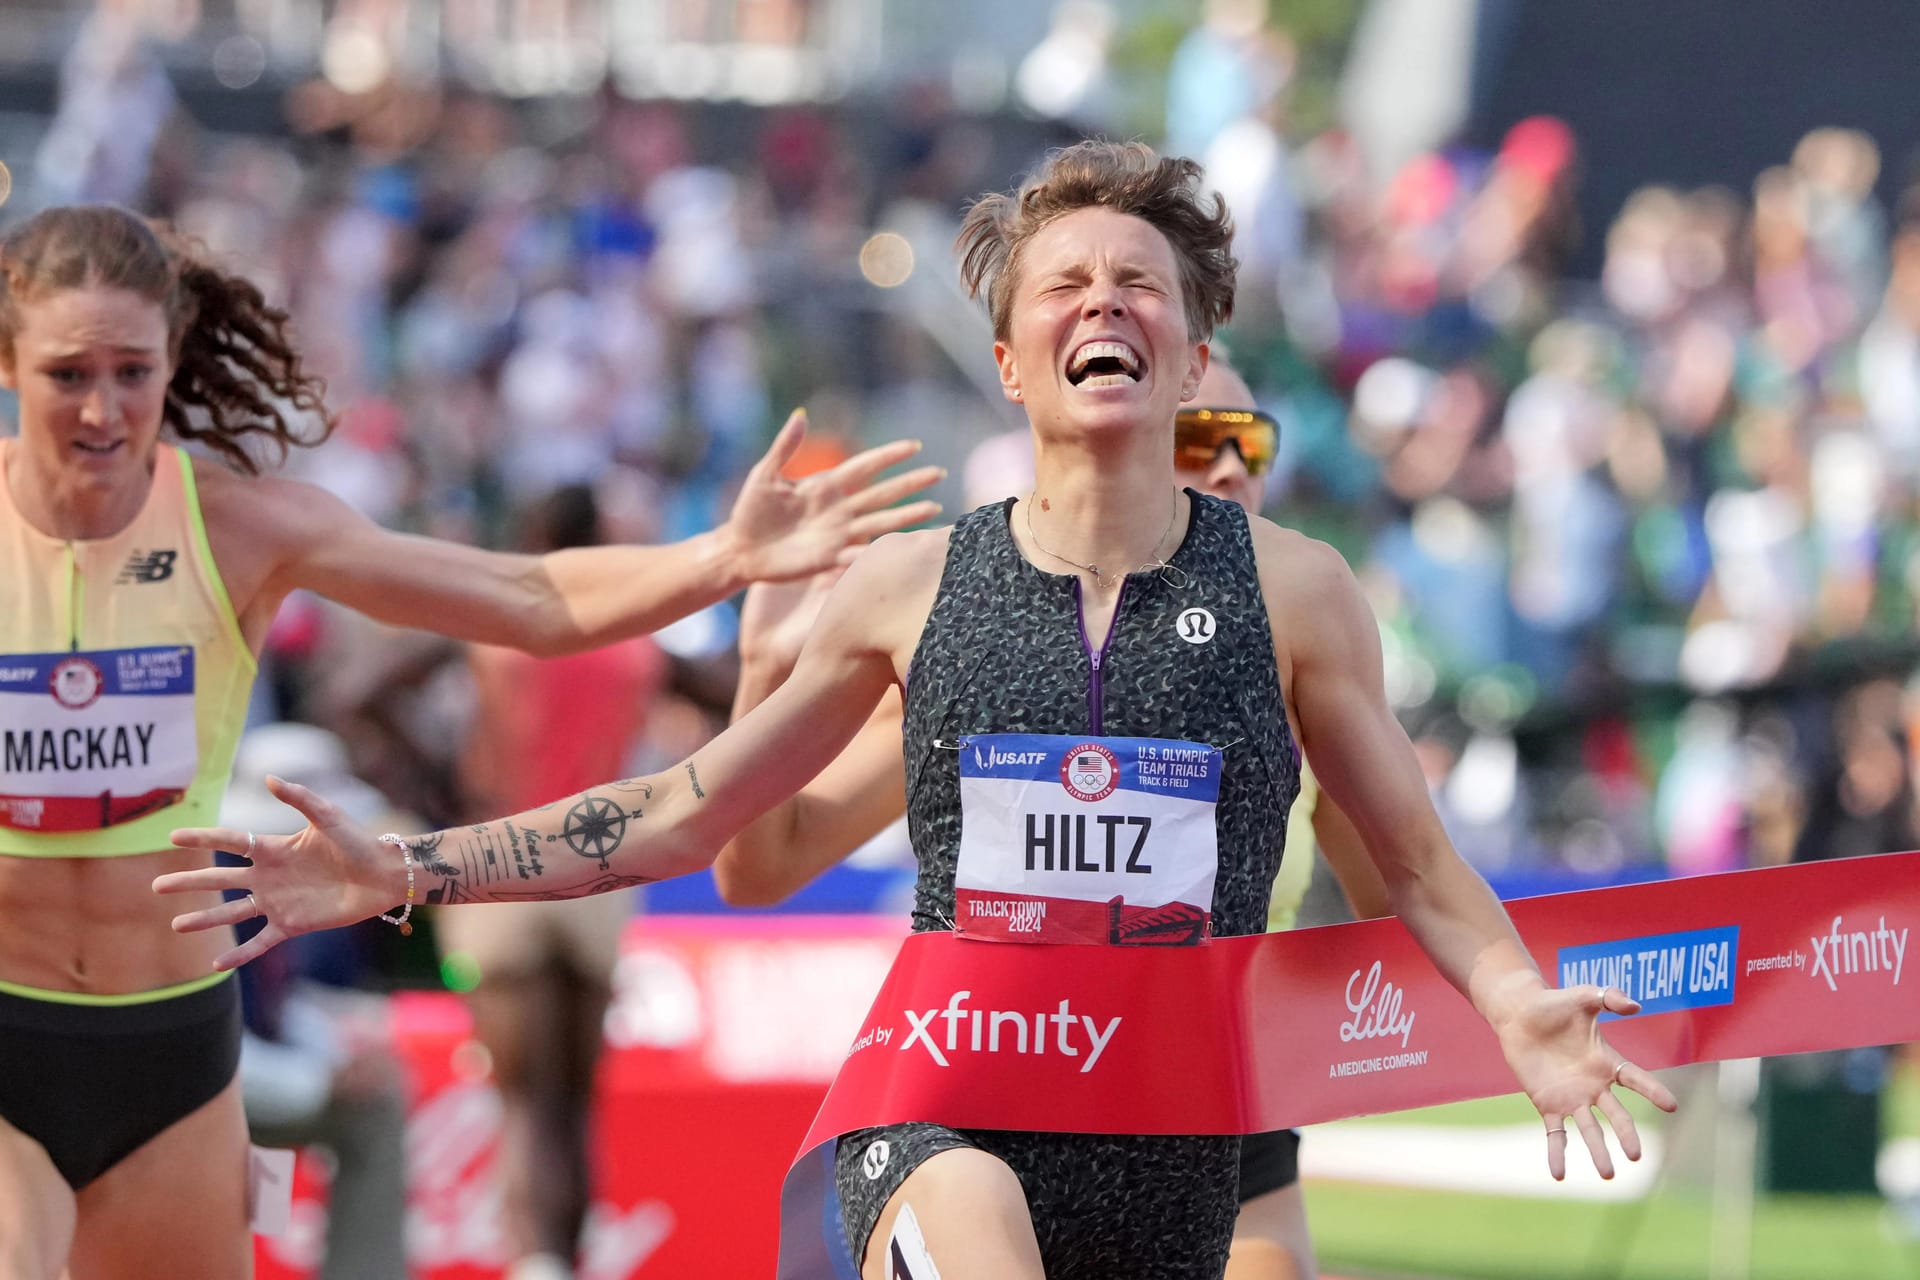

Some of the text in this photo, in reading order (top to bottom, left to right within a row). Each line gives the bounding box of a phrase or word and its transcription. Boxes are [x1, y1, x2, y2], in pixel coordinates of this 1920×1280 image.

[5, 722, 156, 773] MACKAY
[995, 752, 1047, 765] USATF
[1138, 746, 1209, 763] U.S. OLYMPIC
[1137, 760, 1208, 778] TEAM TRIALS
[1138, 776, 1161, 786] TRACK
[1169, 778, 1189, 788] FIELD
[1025, 814, 1153, 874] HILTZ
[968, 900, 1047, 918] TRACKTOWN
[1008, 914, 1042, 933] 2024
[1746, 949, 1807, 976] presented by
[1810, 915, 1909, 991] xfinity
[1637, 947, 1686, 1001] TEAM
[1689, 941, 1729, 994] USA
[1340, 960, 1416, 1048] Lilly
[876, 1025, 895, 1047] by
[899, 990, 1123, 1073] xfinity
[1329, 1051, 1429, 1078] A MEDICINE COMPANY
